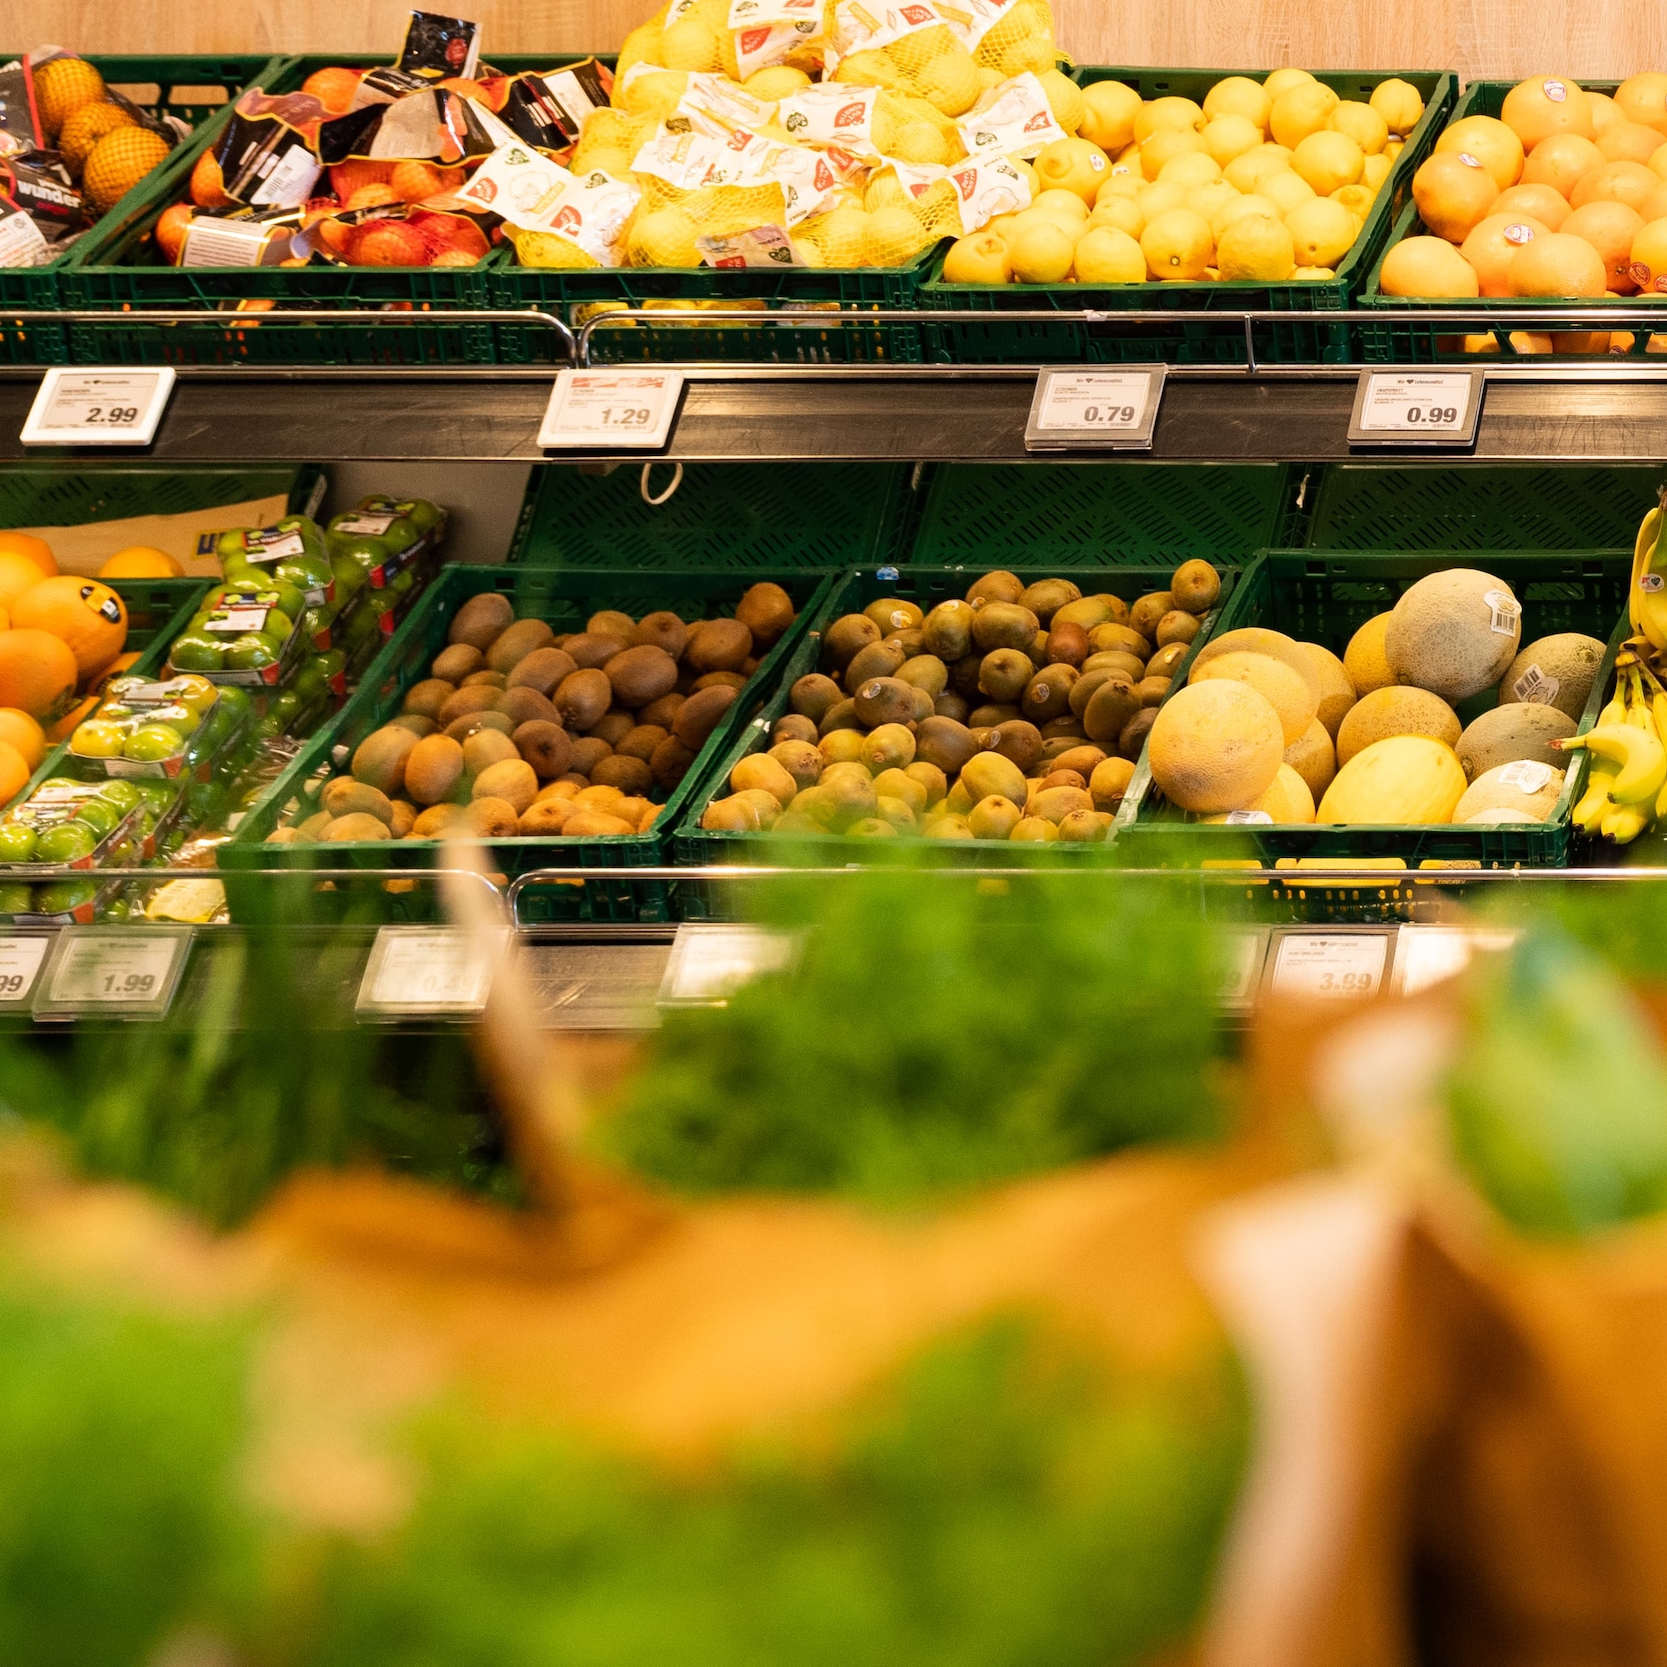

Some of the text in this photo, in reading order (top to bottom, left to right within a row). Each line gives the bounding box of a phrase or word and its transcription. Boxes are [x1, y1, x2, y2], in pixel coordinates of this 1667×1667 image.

[17, 180, 82, 208] wunder
[85, 407, 138, 423] 2.99
[601, 408, 651, 425] 1.29
[1084, 406, 1135, 422] 0.79
[1406, 407, 1458, 423] 0.99
[103, 974, 156, 992] 1.99
[1319, 972, 1372, 991] 3.99
